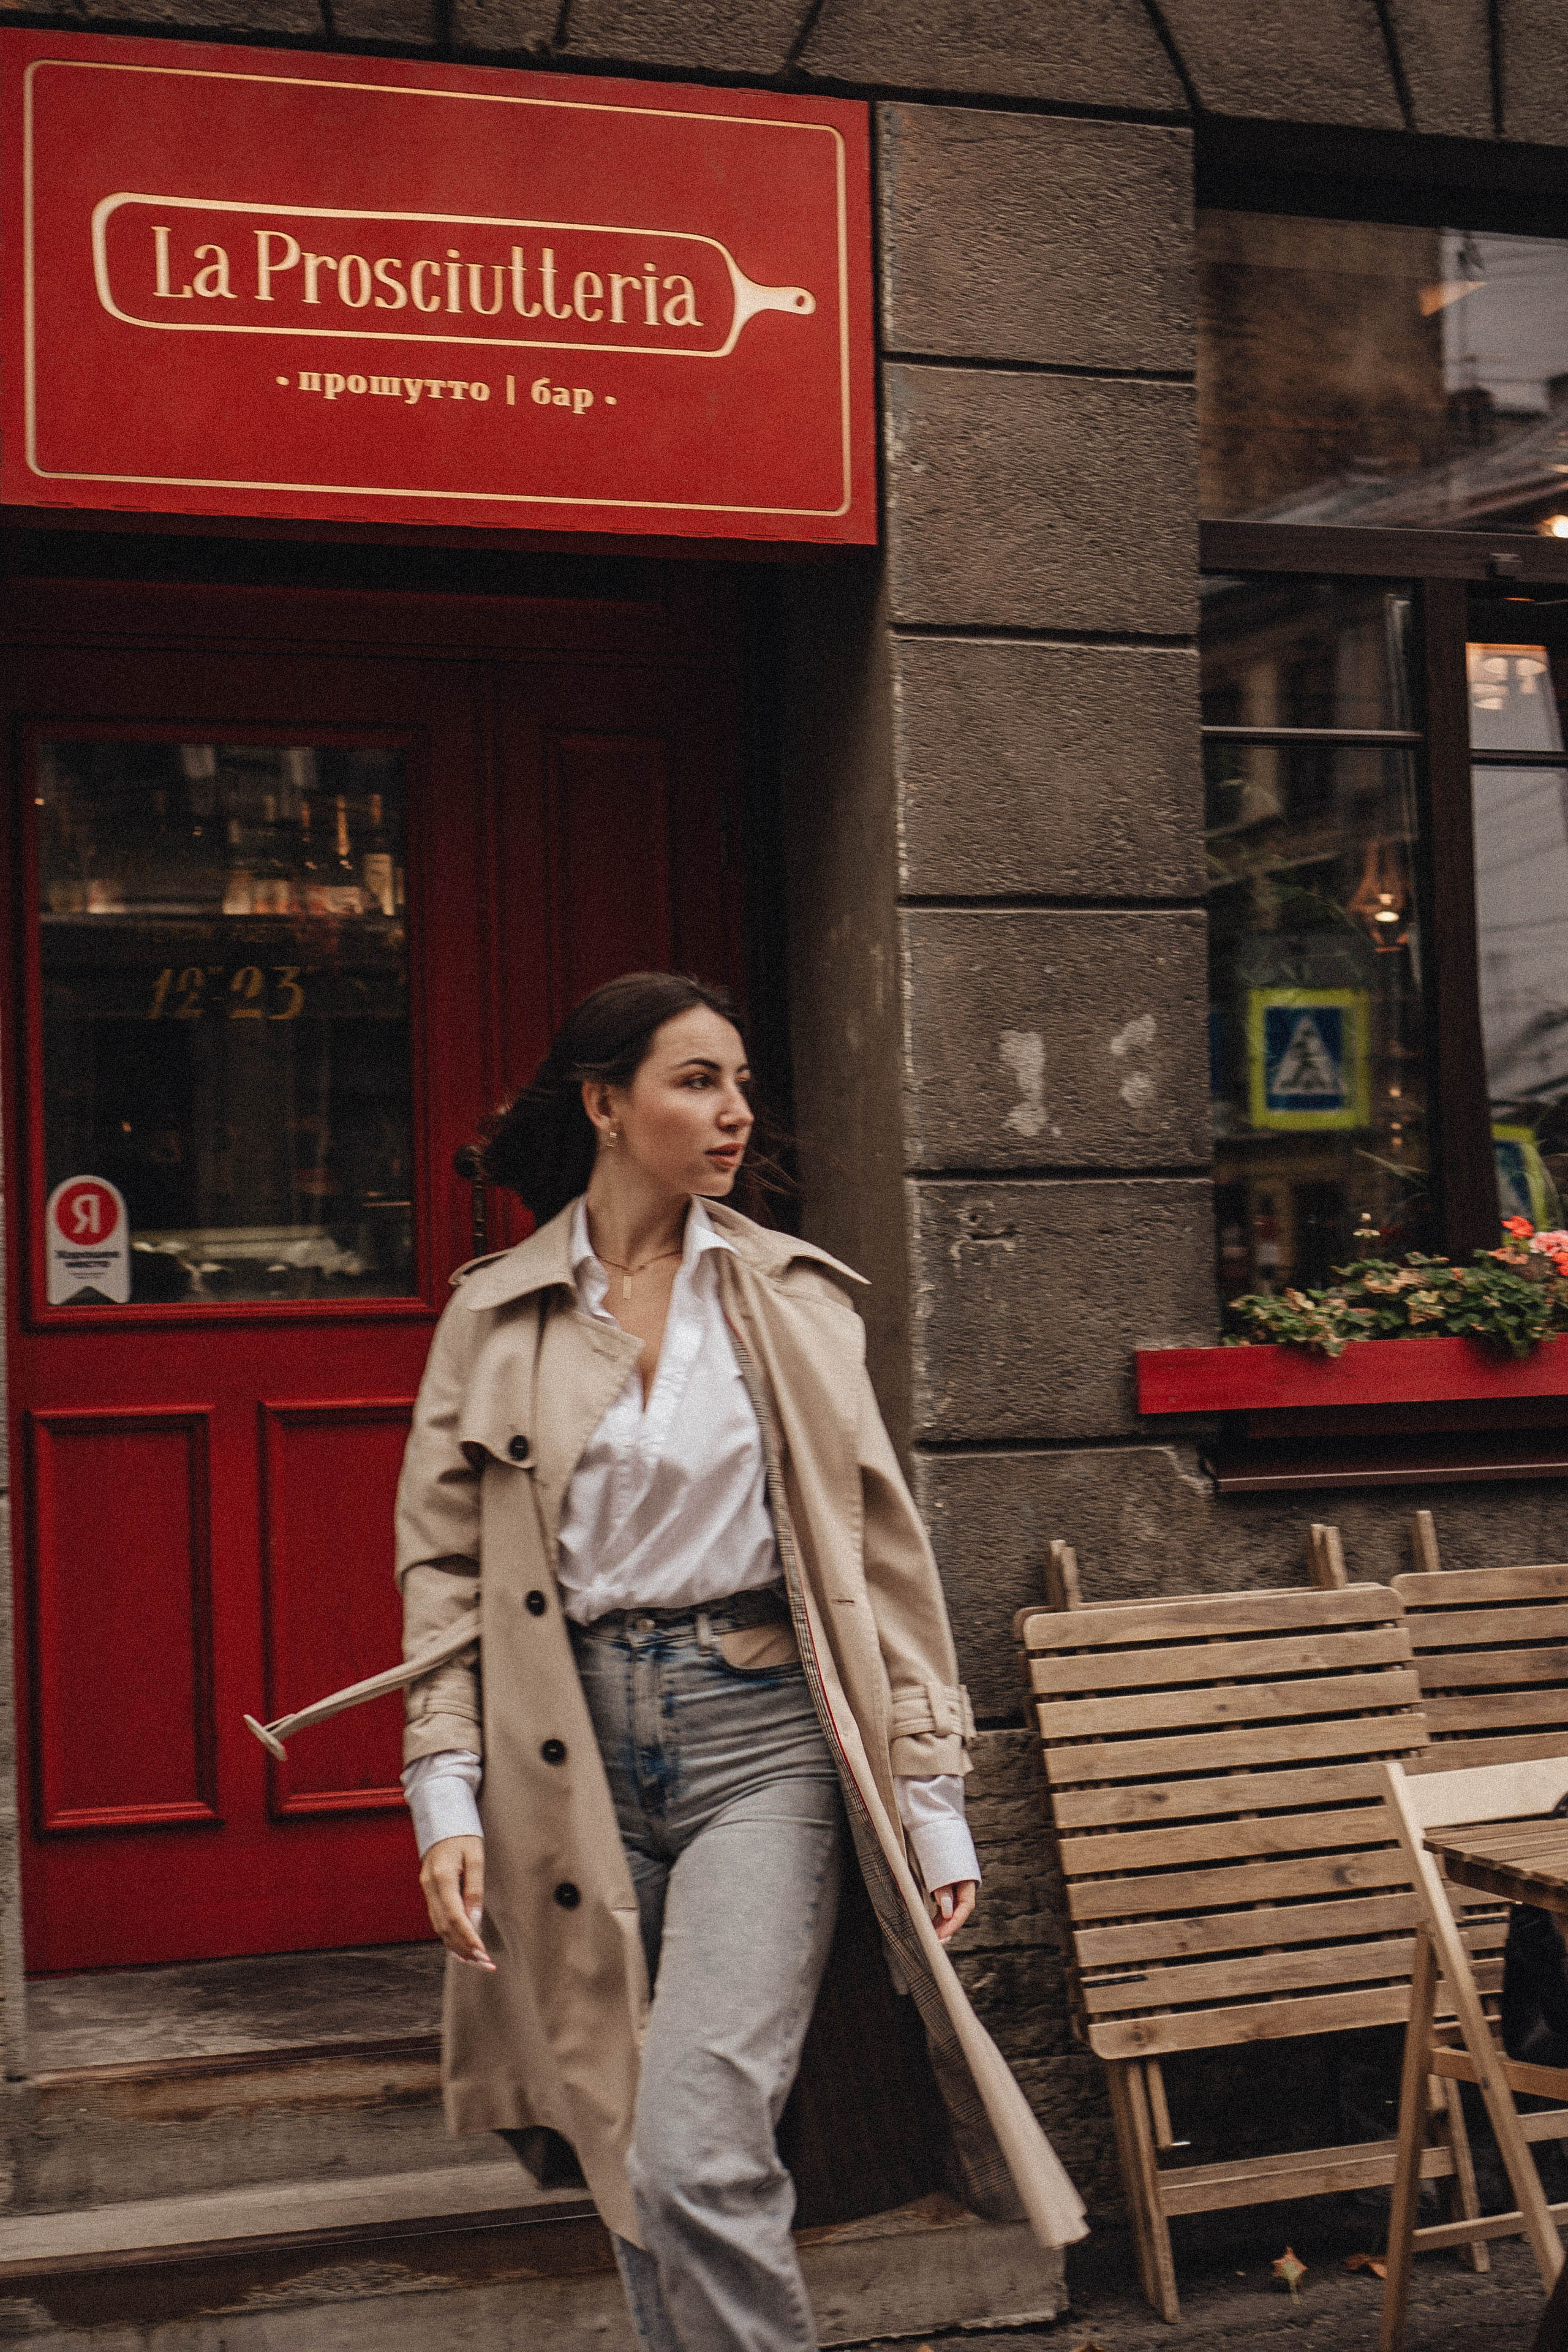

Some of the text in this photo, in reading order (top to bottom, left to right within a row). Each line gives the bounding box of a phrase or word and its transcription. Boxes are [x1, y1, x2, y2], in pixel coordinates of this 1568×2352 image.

[151, 225, 704, 327] La Prosciutteria
[298, 371, 491, 404] прошутто
[531, 376, 595, 415] бар
[72, 1194, 100, 1234] Я
